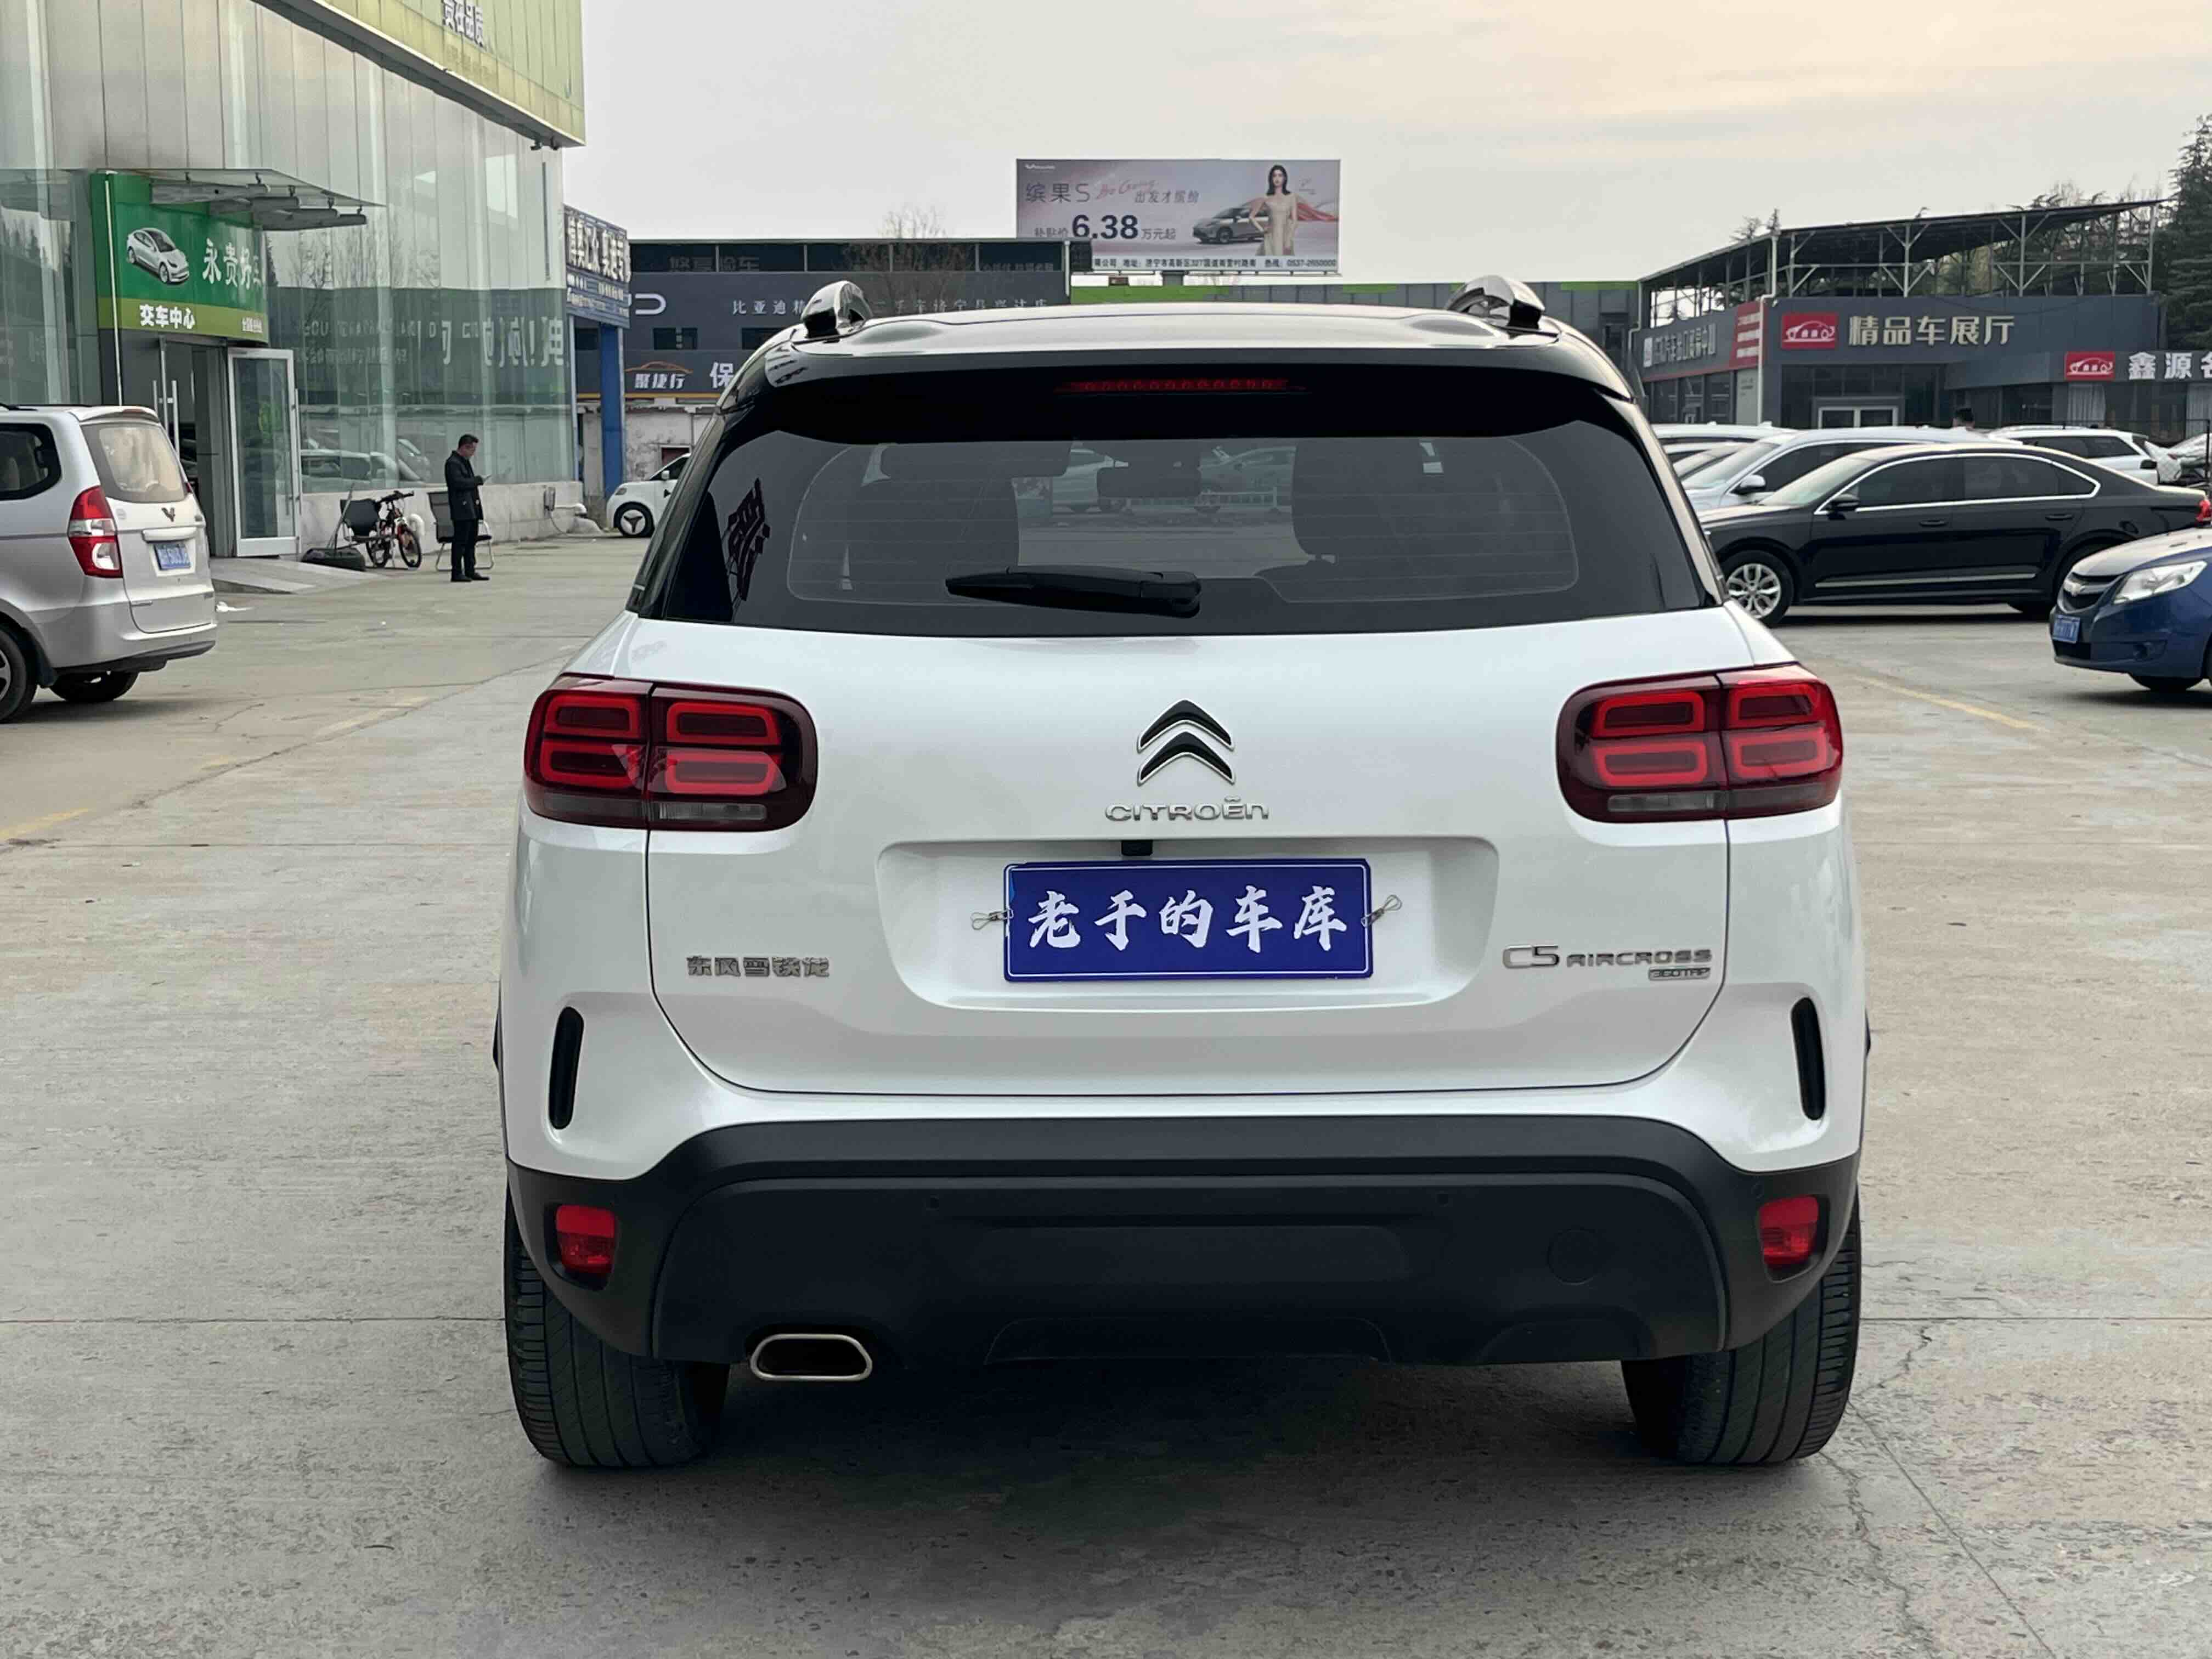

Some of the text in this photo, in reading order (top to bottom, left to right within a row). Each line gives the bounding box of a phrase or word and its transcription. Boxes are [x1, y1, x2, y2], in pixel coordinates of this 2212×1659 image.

[1072, 214, 1138, 239] 6.38
[1141, 228, 1177, 240] 万元起
[1848, 315, 2015, 346] 精品车展厅
[709, 362, 734, 388] 保
[686, 956, 830, 977] 东风雪铁龙
[1503, 945, 1712, 969] C5 AIRCROSS
